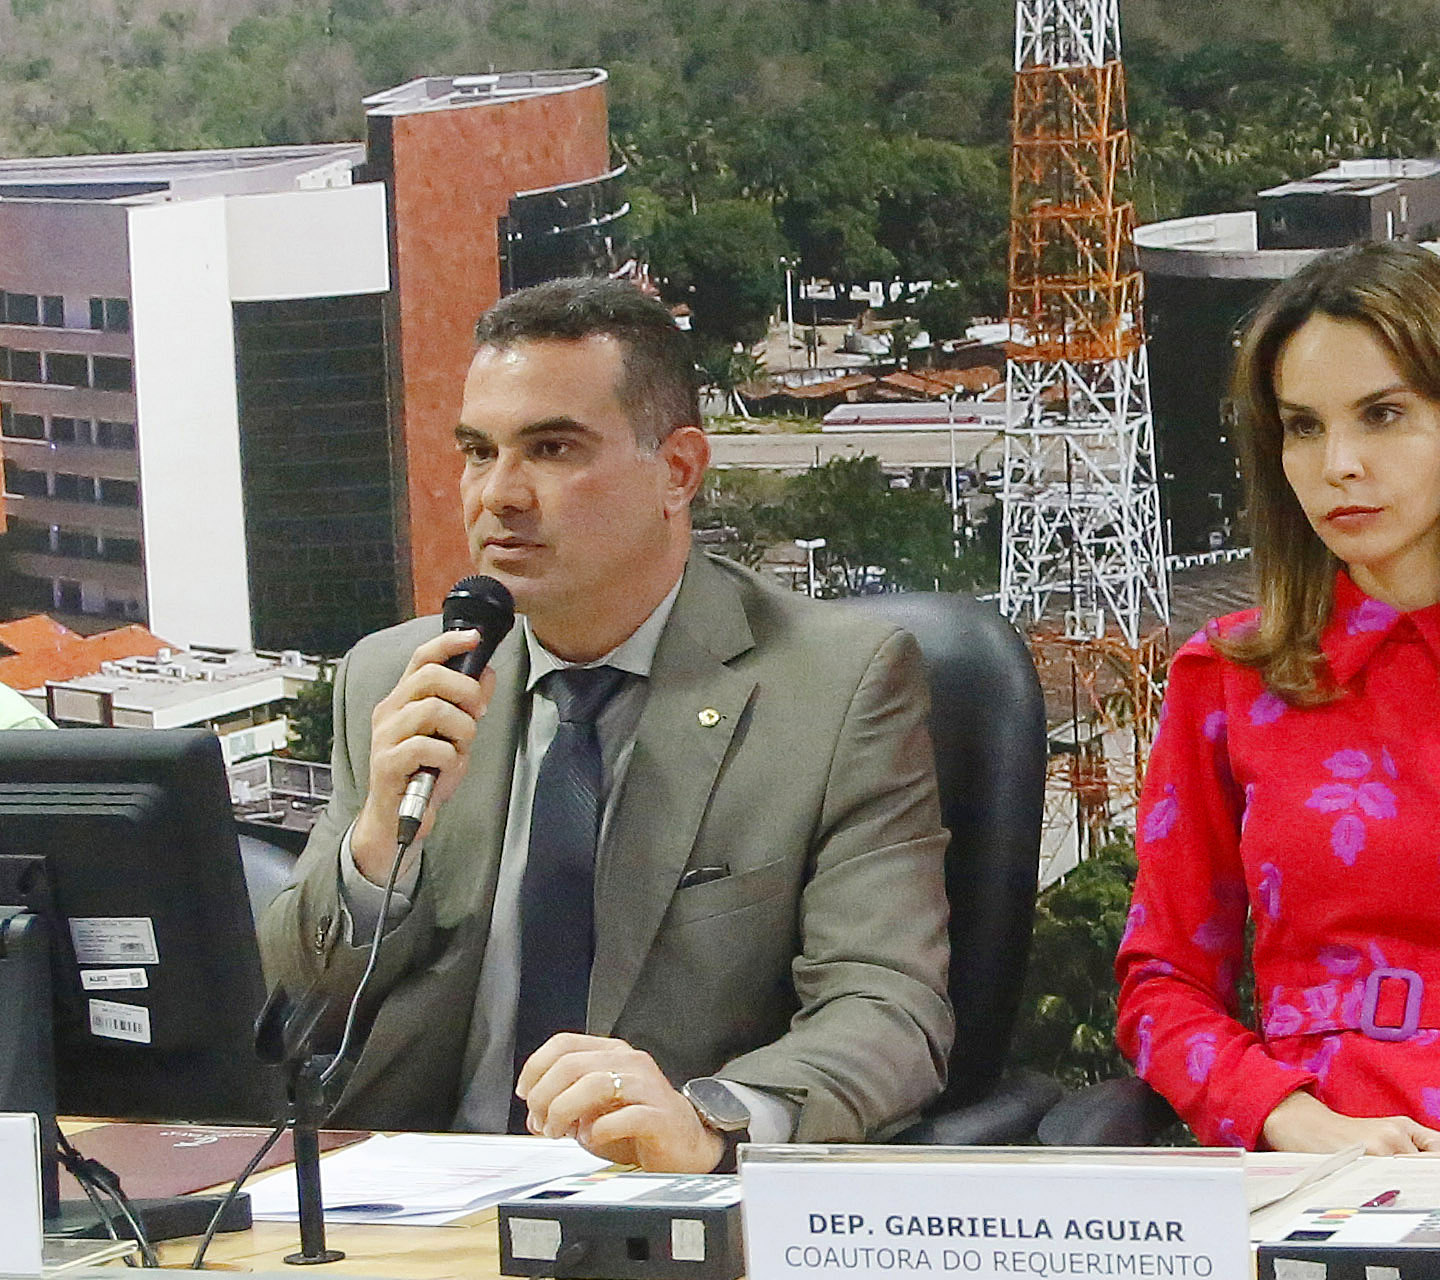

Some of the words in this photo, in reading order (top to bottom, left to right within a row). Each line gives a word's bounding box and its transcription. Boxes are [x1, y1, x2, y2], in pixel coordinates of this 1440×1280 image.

[809, 1213, 875, 1236] DEP.
[885, 1215, 1053, 1239] GABRIELLA
[1064, 1219, 1186, 1242] AGUIAR
[785, 1245, 933, 1271] COAUTORA
[943, 1249, 982, 1272] DO
[993, 1250, 1213, 1278] REQUERIMENTO
